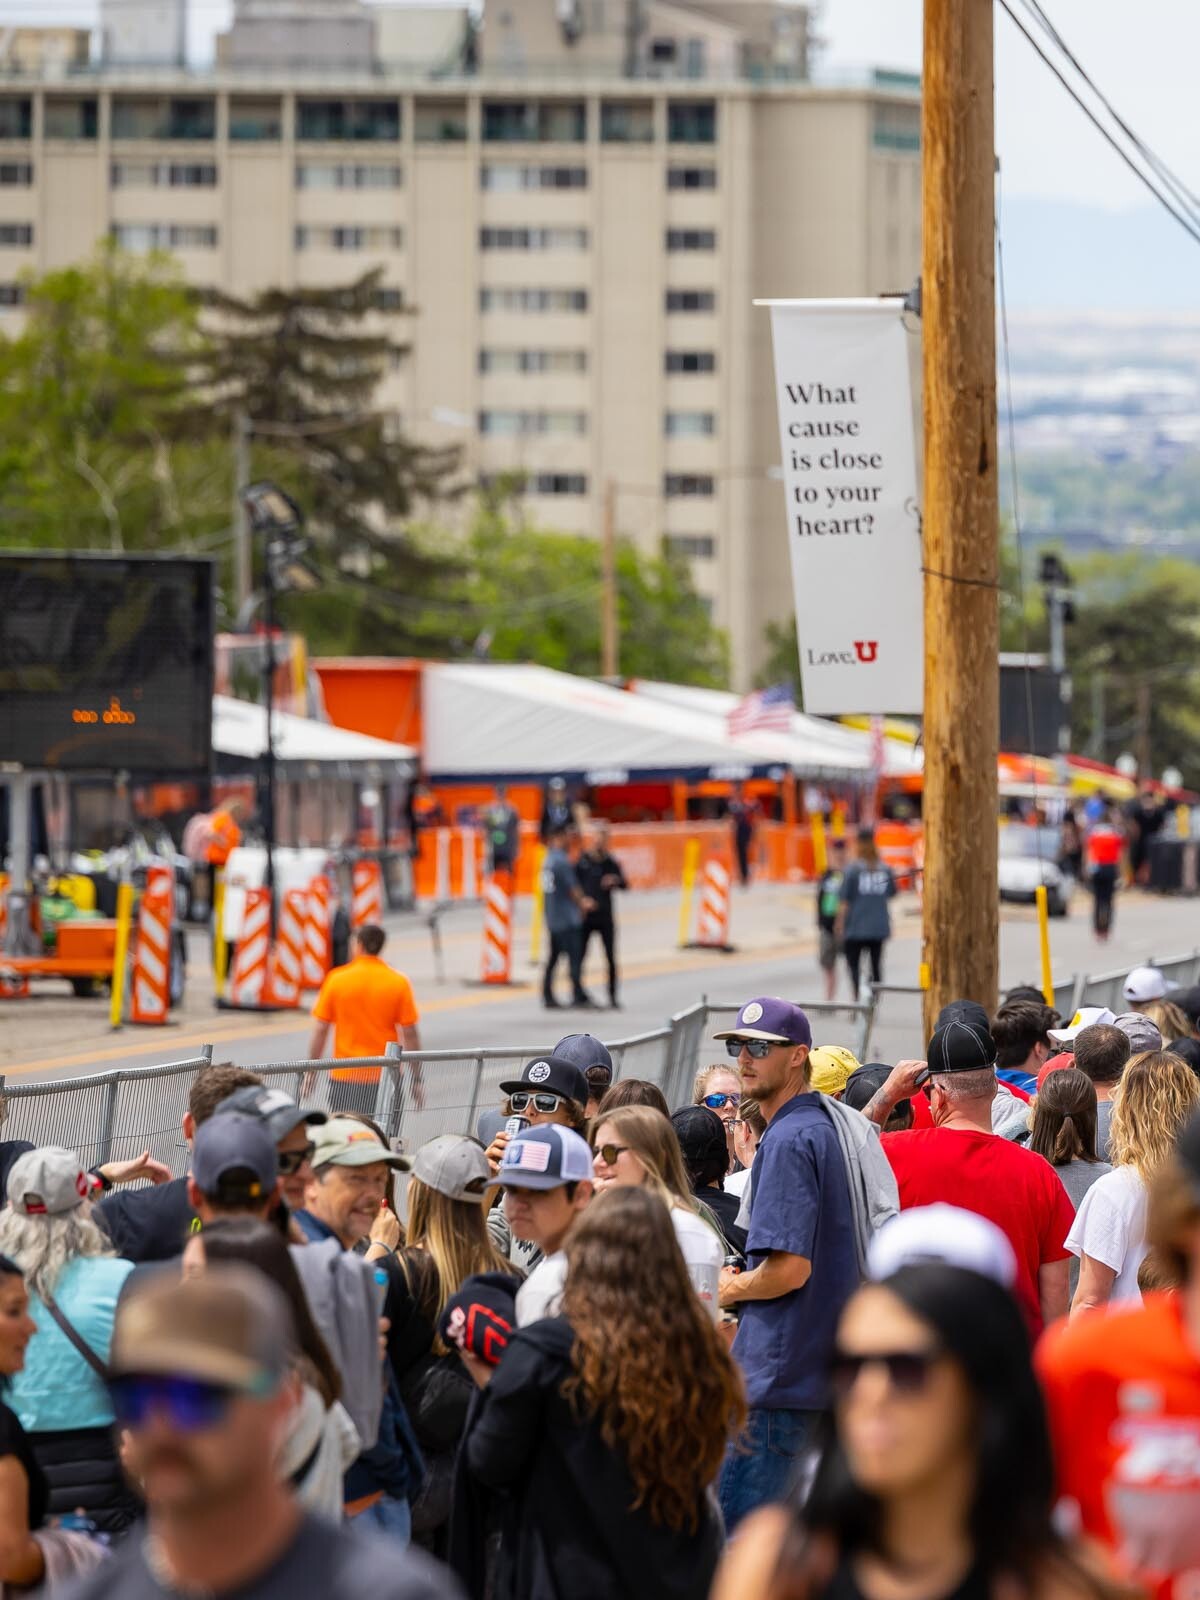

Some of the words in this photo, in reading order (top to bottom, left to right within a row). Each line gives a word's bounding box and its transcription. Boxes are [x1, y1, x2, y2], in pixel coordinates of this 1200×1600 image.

[786, 383, 857, 405] What
[788, 421, 860, 439] cause
[791, 449, 812, 471] is
[819, 447, 883, 470] close
[794, 486, 819, 504] to
[825, 486, 882, 509] your
[796, 513, 875, 537] heart?
